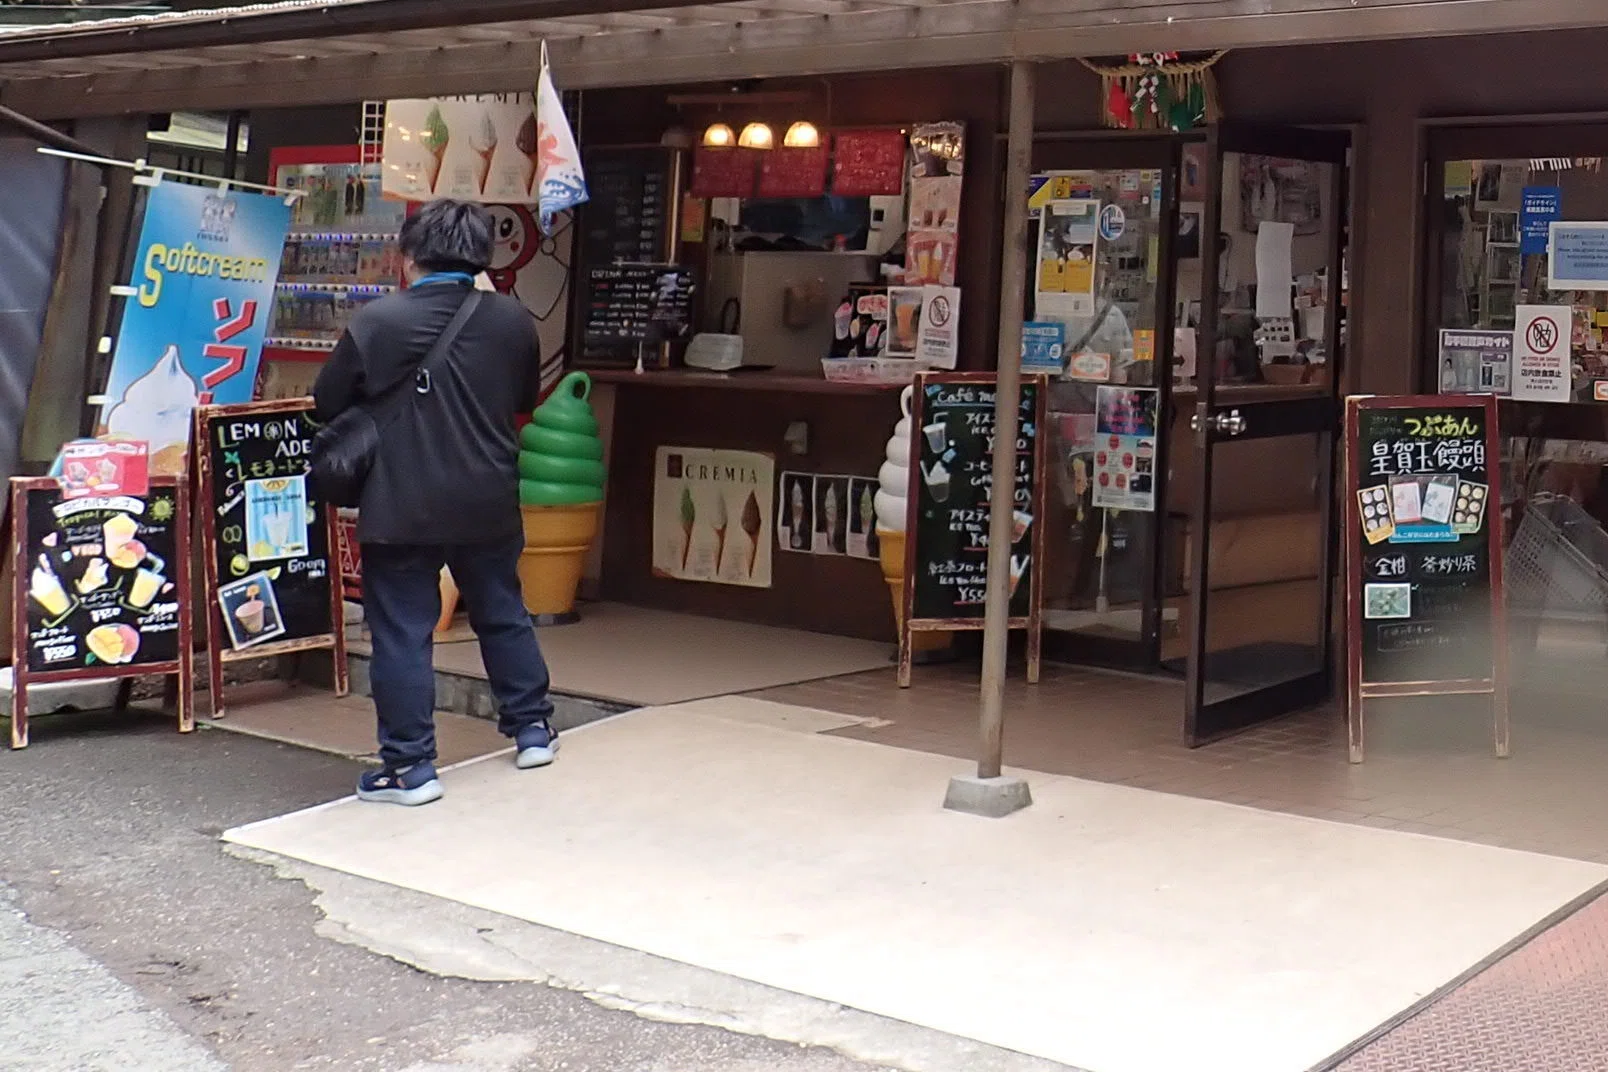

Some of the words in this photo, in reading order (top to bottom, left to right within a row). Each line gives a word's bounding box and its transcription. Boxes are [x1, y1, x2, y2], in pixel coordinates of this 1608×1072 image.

[139, 243, 266, 307] Softcream
[938, 388, 974, 403] Café
[274, 439, 312, 459] ADE
[1370, 438, 1486, 476] 皇賀玉饅頭
[685, 463, 758, 485] CREMIA
[1375, 555, 1406, 576] 金柑
